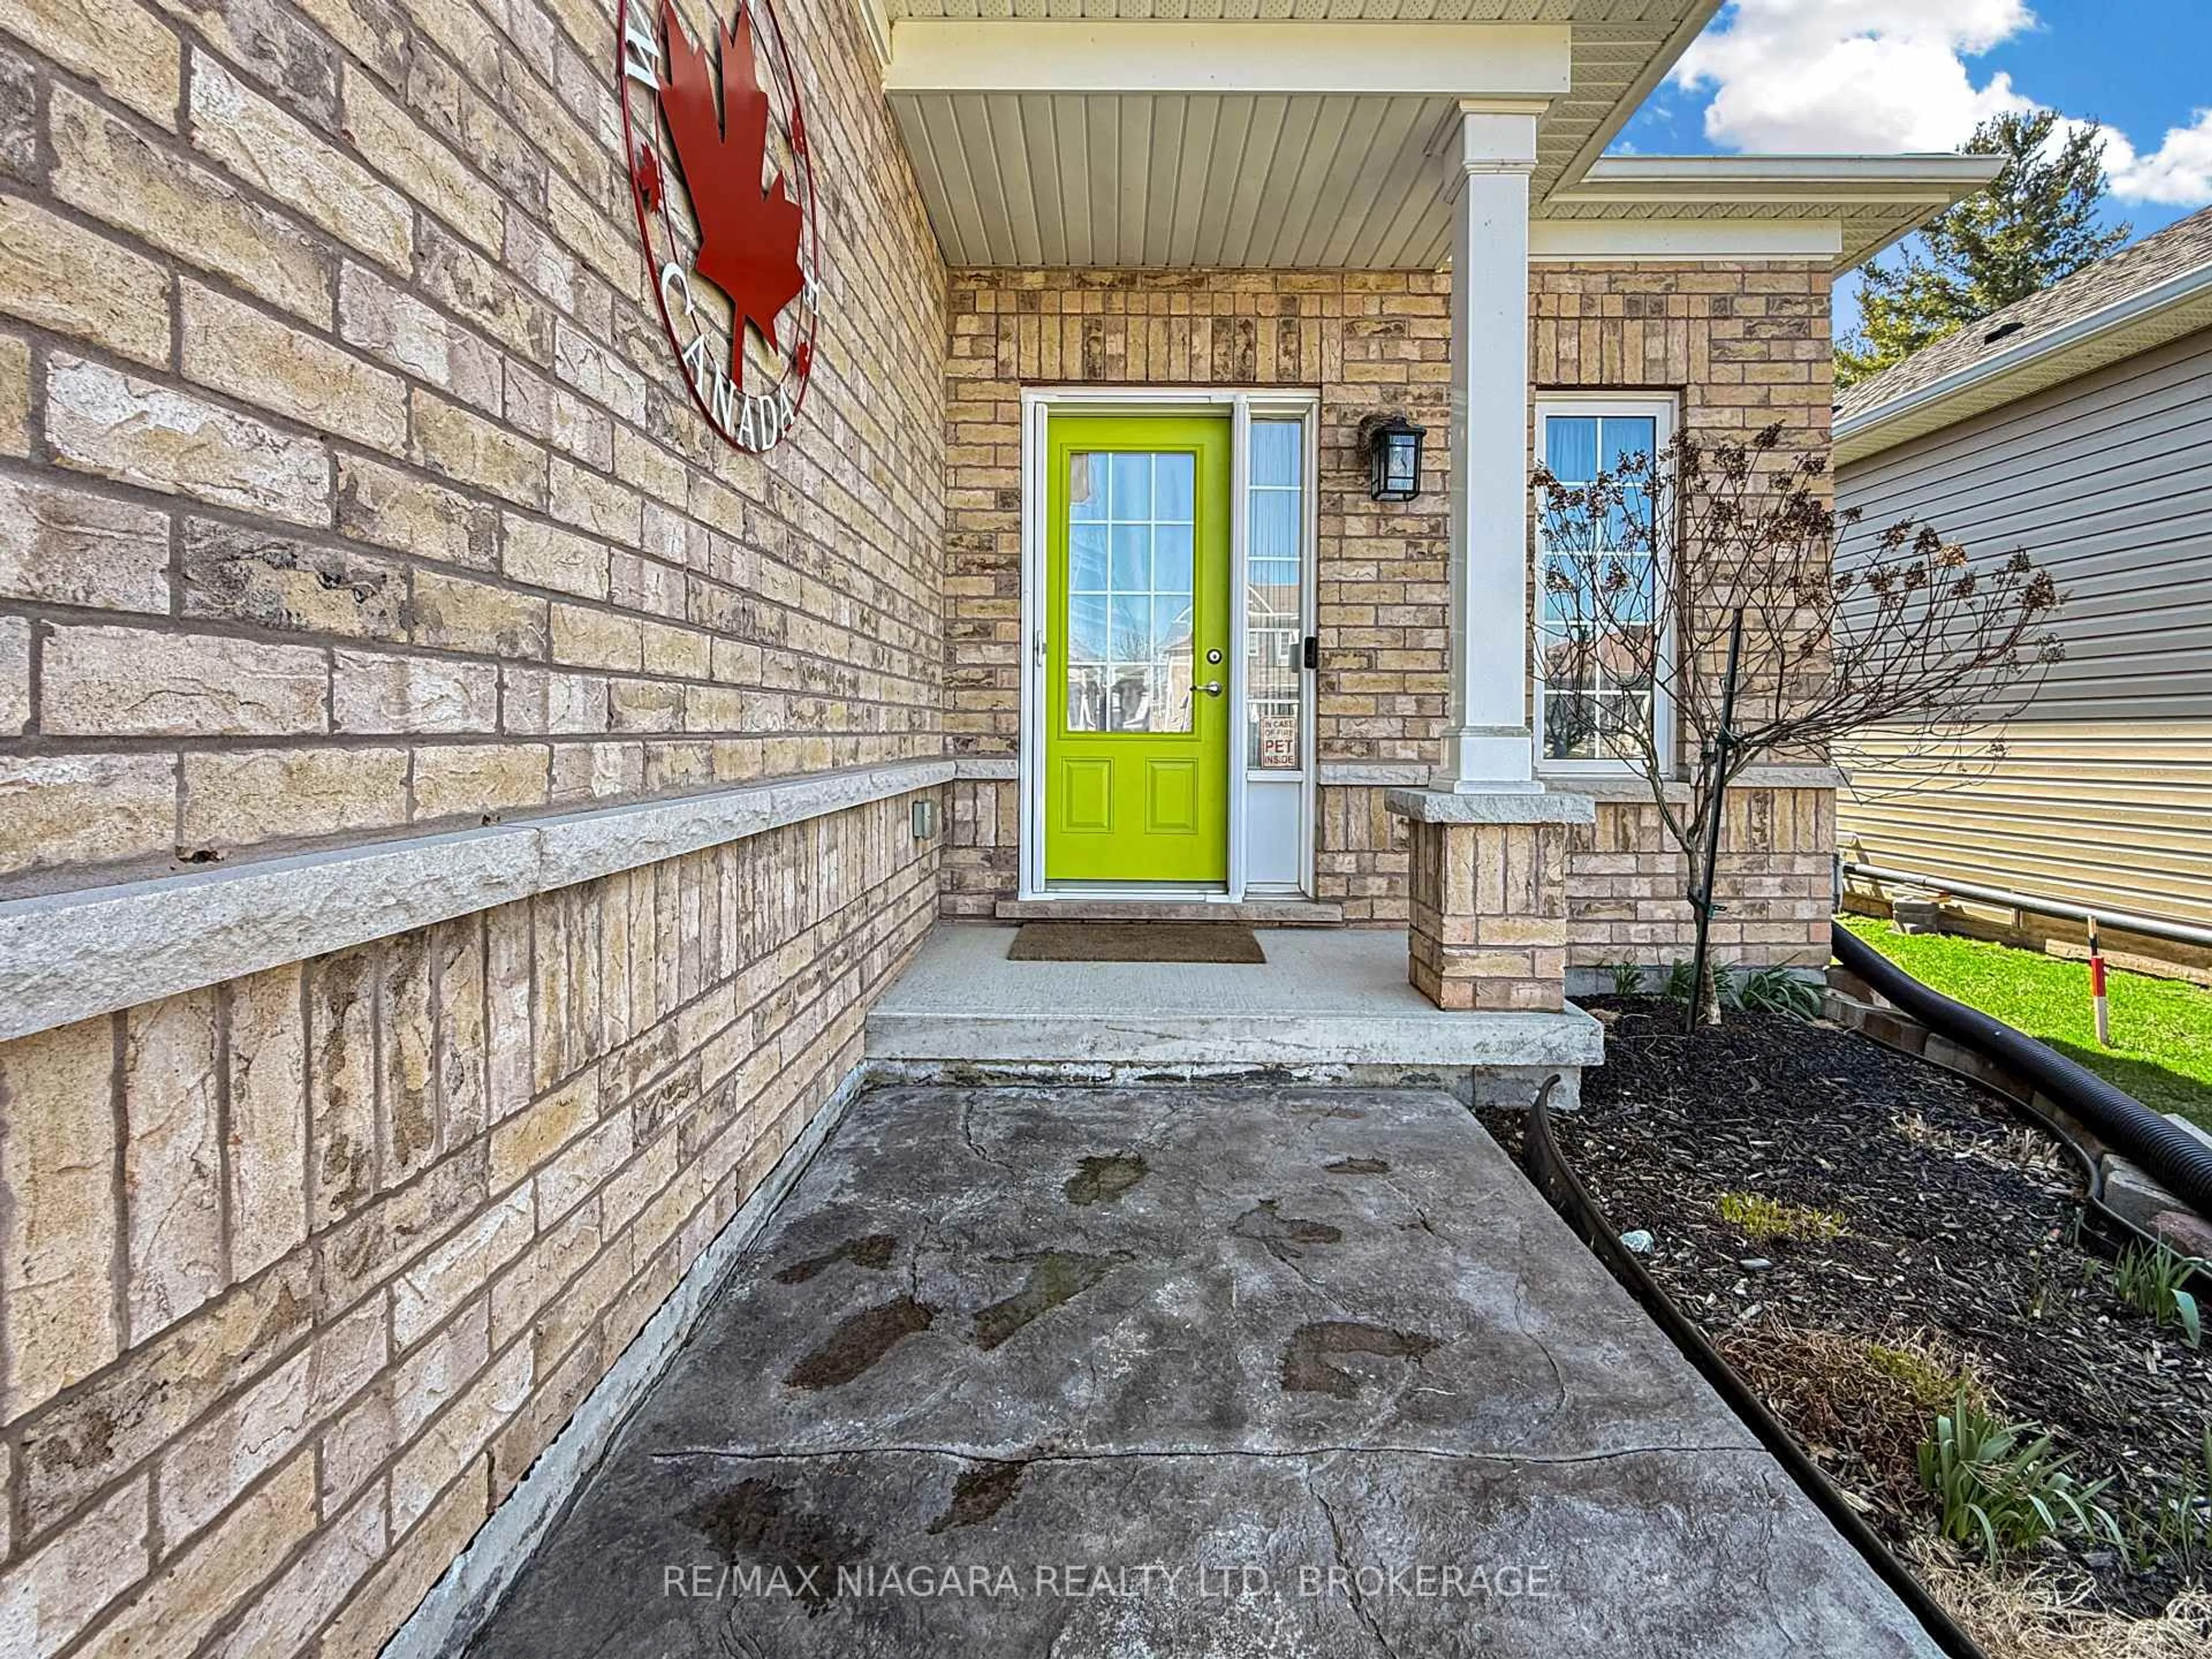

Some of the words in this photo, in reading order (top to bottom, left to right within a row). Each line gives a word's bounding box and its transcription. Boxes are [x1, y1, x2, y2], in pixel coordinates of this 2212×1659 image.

[661, 262, 796, 453] CANADA
[1266, 740, 1293, 753] PET
[1265, 756, 1293, 764] INSIDE
